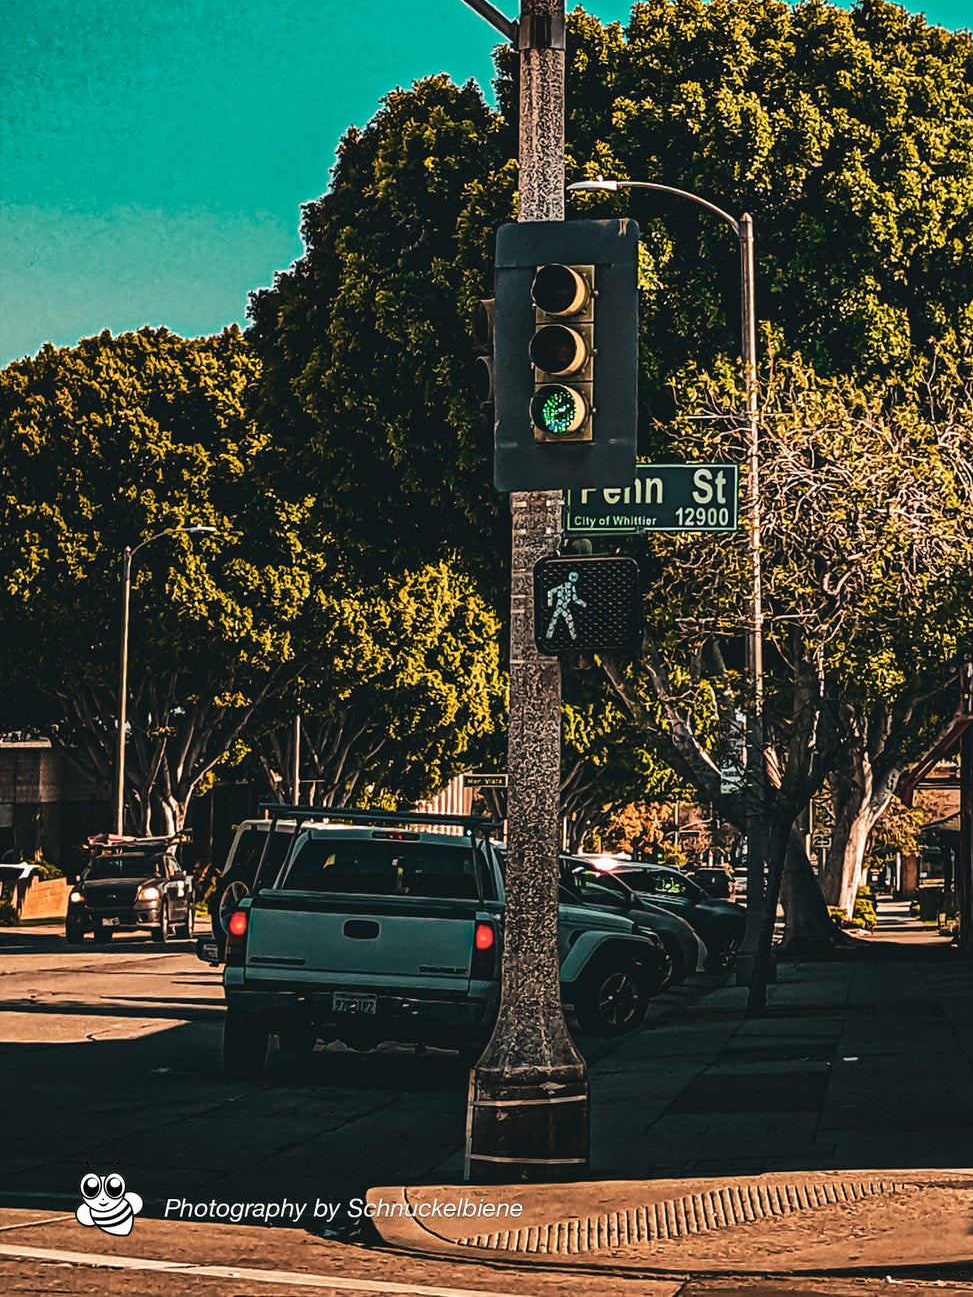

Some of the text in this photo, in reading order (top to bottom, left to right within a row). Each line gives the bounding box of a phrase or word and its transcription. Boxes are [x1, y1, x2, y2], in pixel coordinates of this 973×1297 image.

[692, 468, 727, 504] St
[574, 515, 657, 528] City of Whittier
[675, 507, 729, 526] 12900
